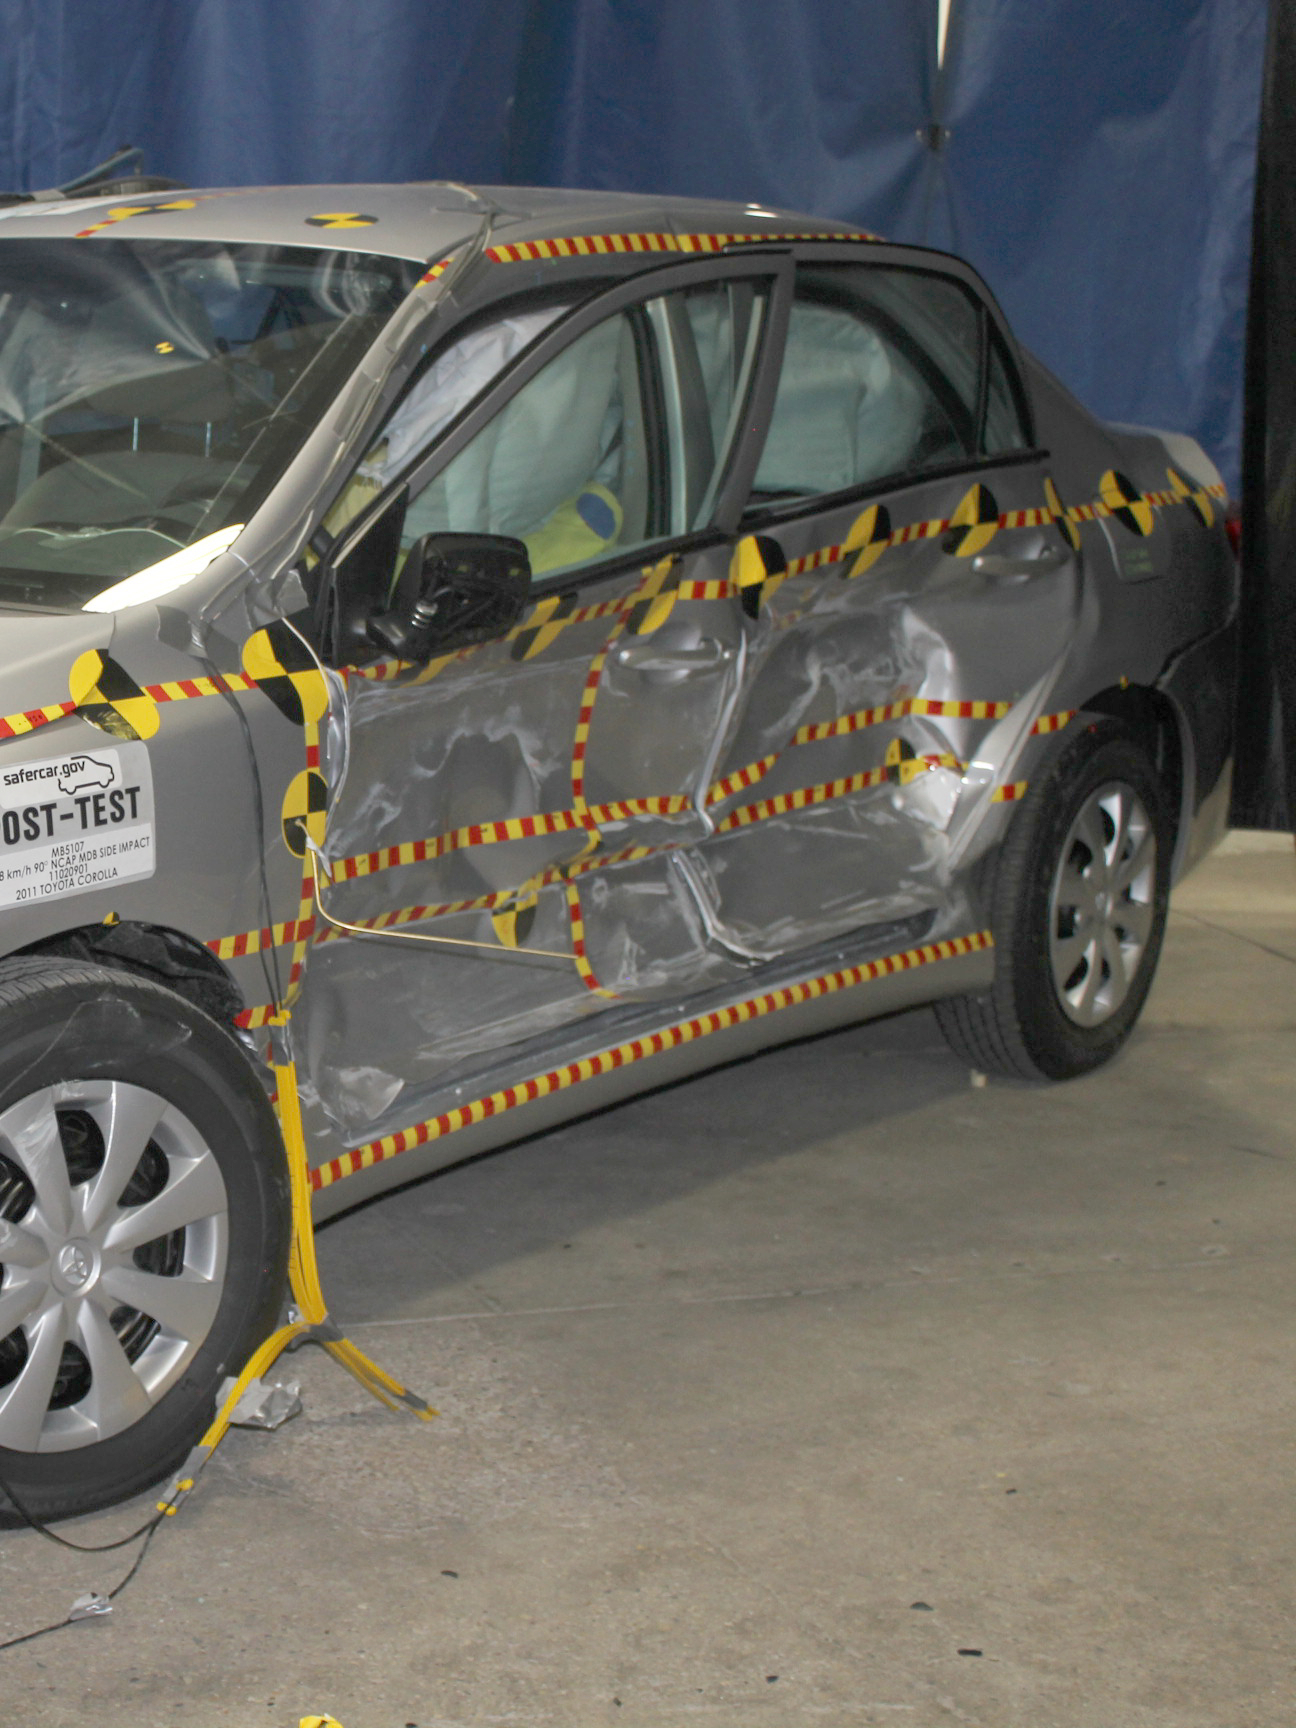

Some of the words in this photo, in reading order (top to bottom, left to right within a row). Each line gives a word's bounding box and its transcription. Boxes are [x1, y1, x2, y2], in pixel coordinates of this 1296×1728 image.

[3, 760, 86, 786] safercar.gov
[7, 865, 32, 880] km/h
[51, 854, 77, 870] NCAP
[79, 849, 98, 863] MDB
[99, 844, 117, 858] SIDE
[119, 836, 150, 852] IMPACT
[51, 841, 85, 858] MB5107
[16, 886, 37, 901] 2011
[40, 877, 75, 895] TOYOTA
[77, 867, 119, 886] COROLLA
[49, 863, 88, 881] 11020901
